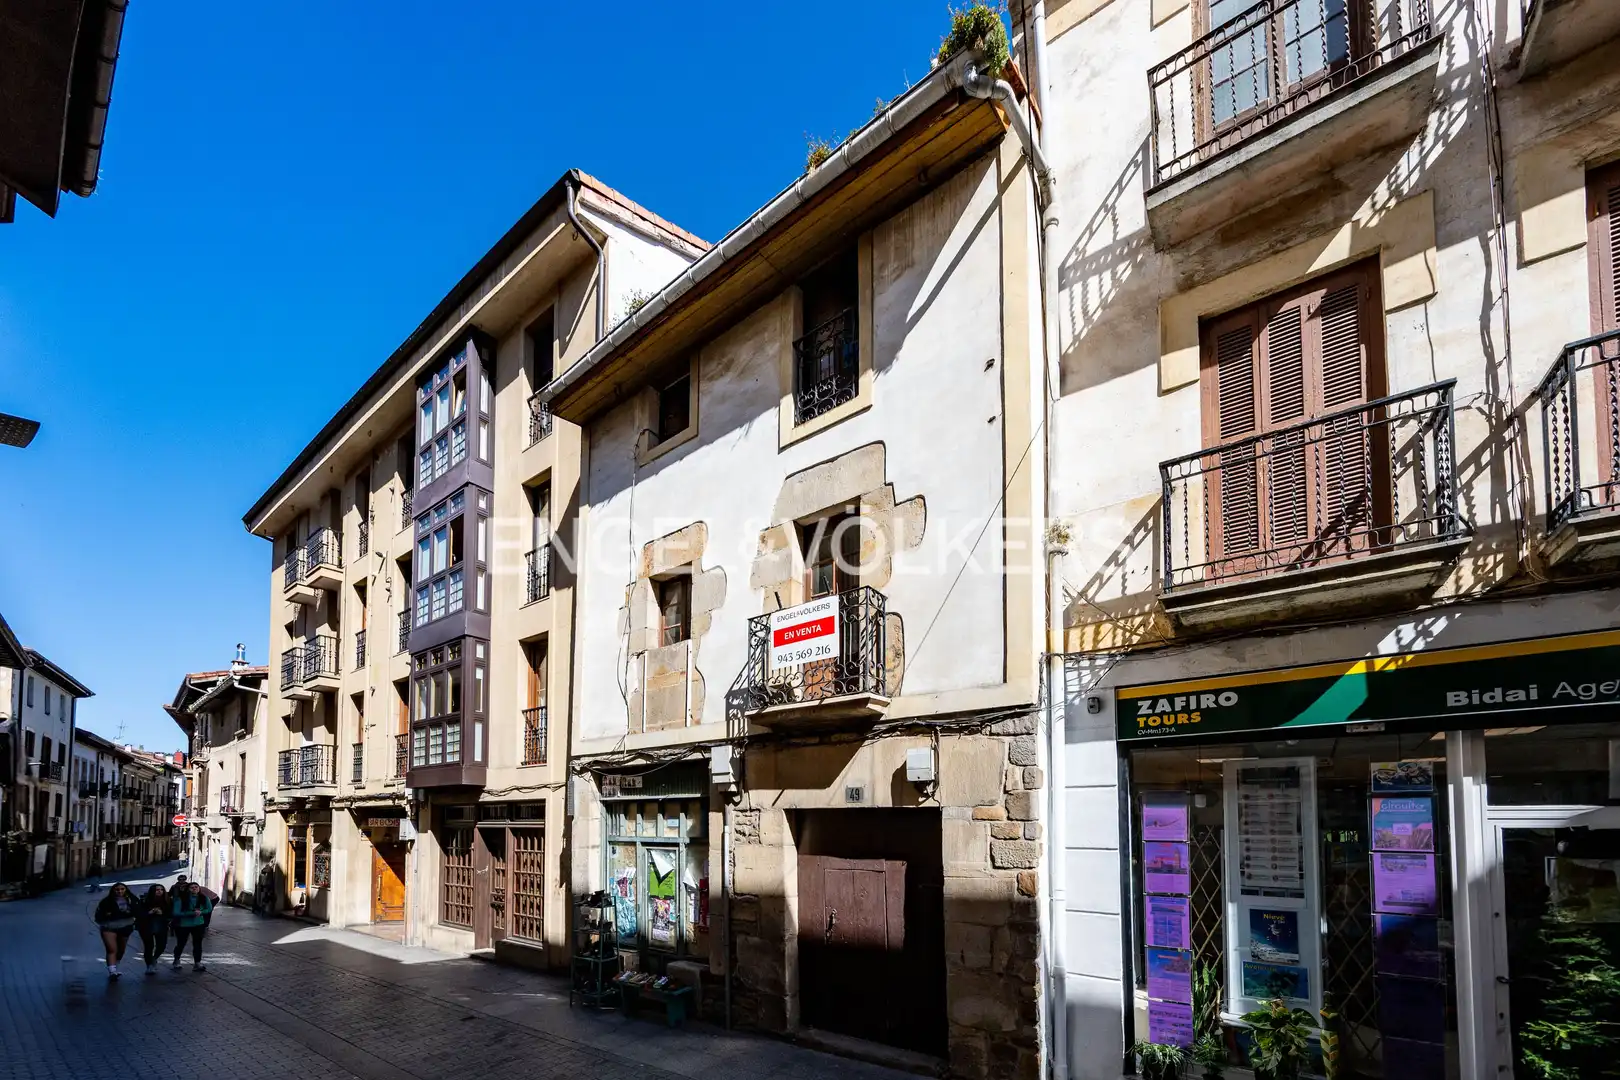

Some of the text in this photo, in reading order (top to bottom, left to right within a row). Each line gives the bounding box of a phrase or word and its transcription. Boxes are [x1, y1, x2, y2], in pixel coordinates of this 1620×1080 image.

[784, 624, 822, 640] EN VENTA
[777, 643, 831, 664] 943 569 216
[1446, 679, 1620, 707] Bidai Age
[1137, 691, 1239, 715] ZAFIRO
[1136, 711, 1202, 728] TOURS
[849, 788, 860, 801] 49
